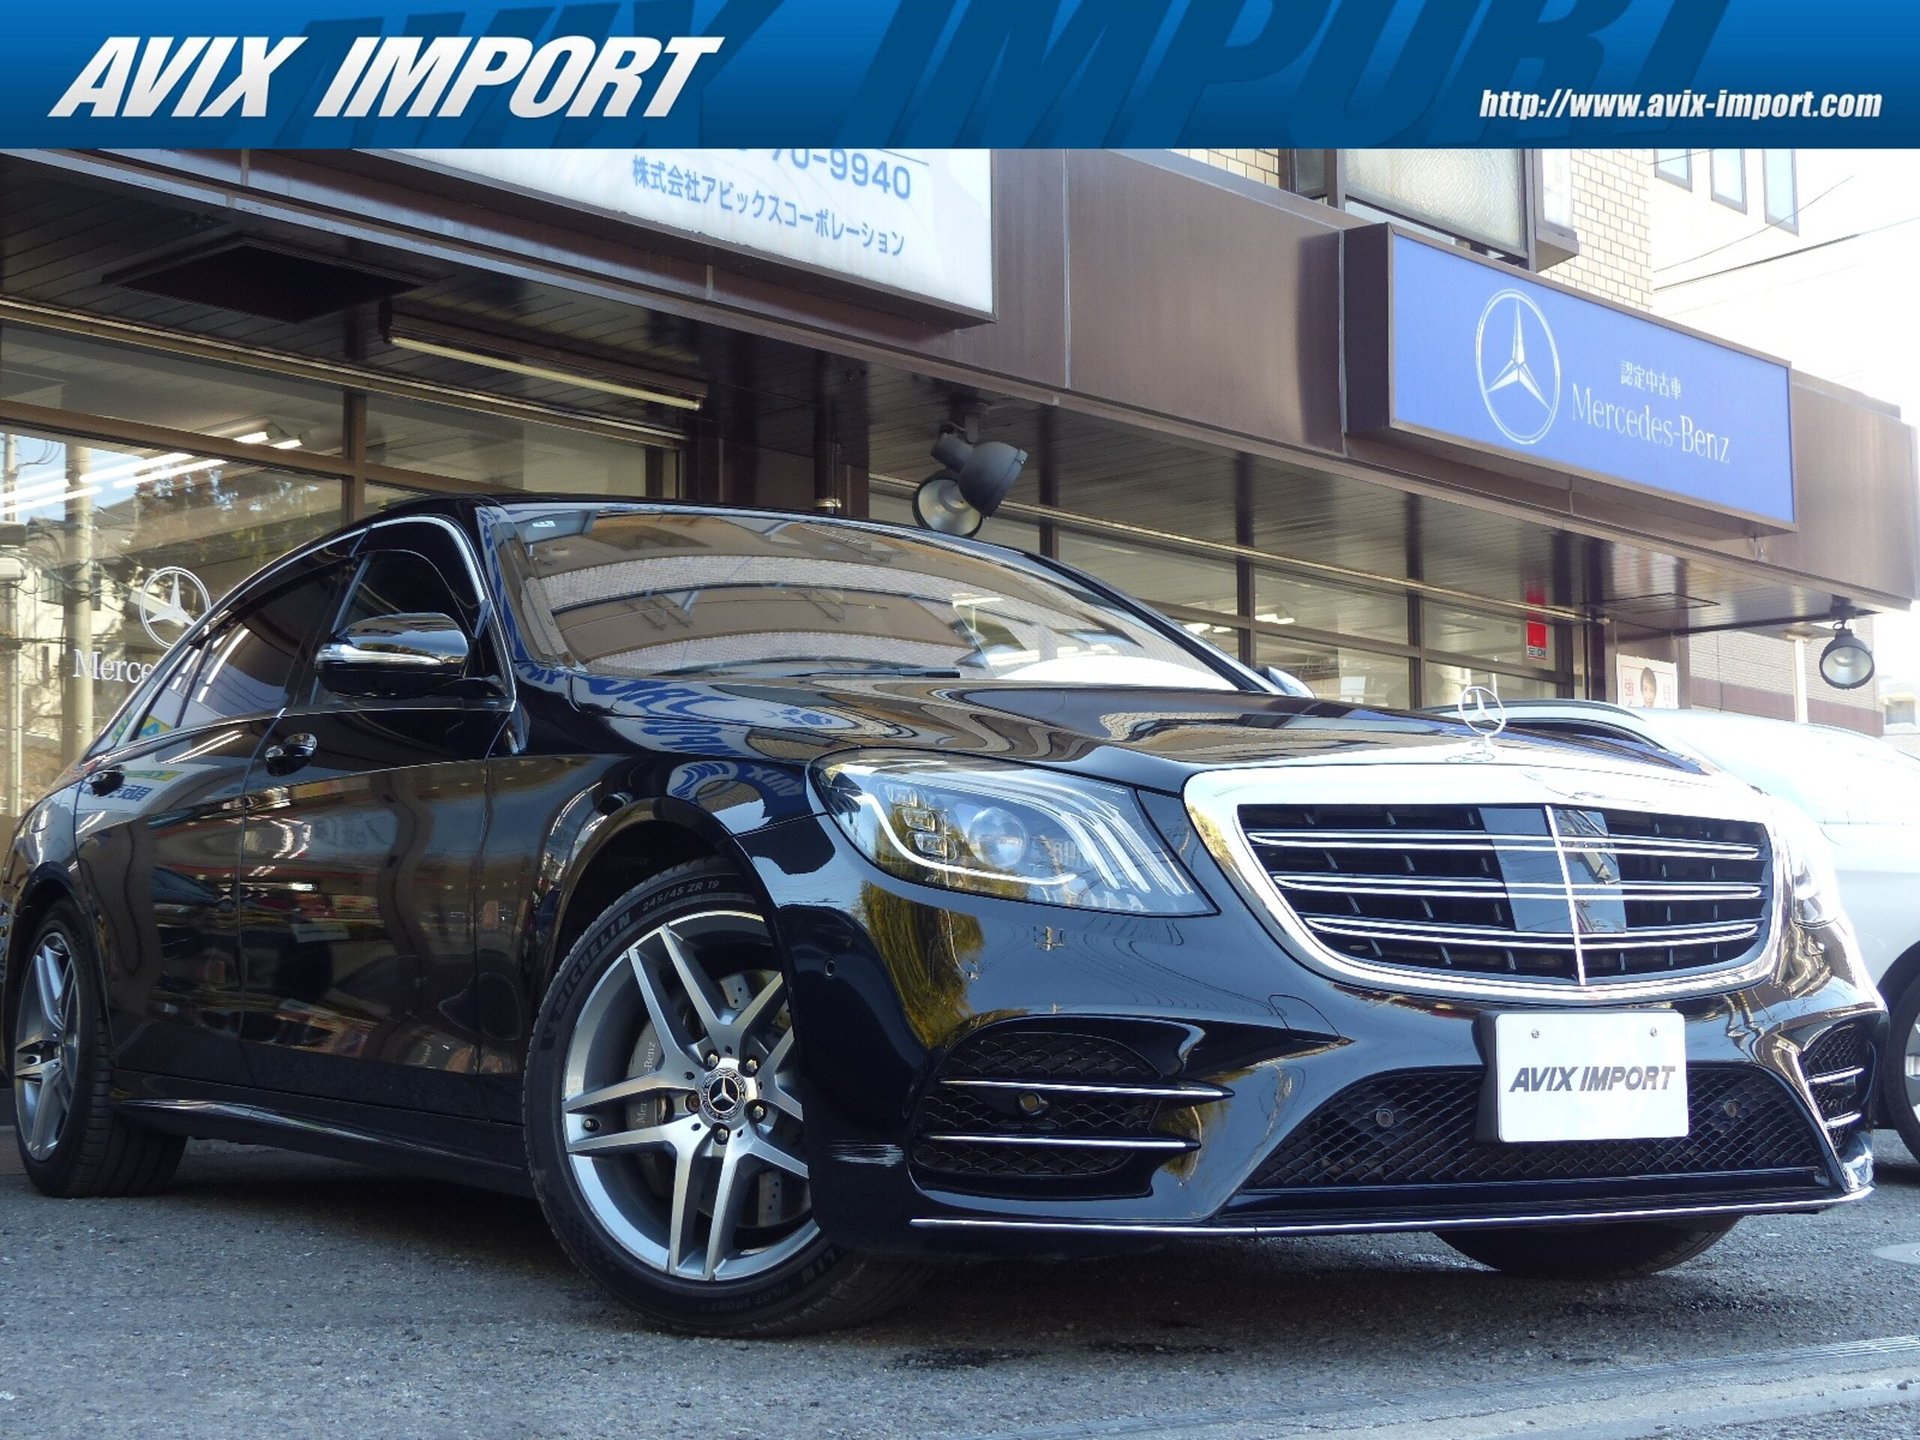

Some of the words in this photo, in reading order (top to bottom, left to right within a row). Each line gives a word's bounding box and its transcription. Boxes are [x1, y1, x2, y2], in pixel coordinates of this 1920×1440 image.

[632, 154, 904, 256] 株式会社アビックスコーポレーション
[1620, 360, 1682, 400] 認定中古車
[1571, 382, 1730, 464] Mercedes-Benz
[72, 648, 154, 684] Merce
[1508, 1066, 1579, 1093] AVIX
[1579, 1065, 1676, 1092] IMPORT
